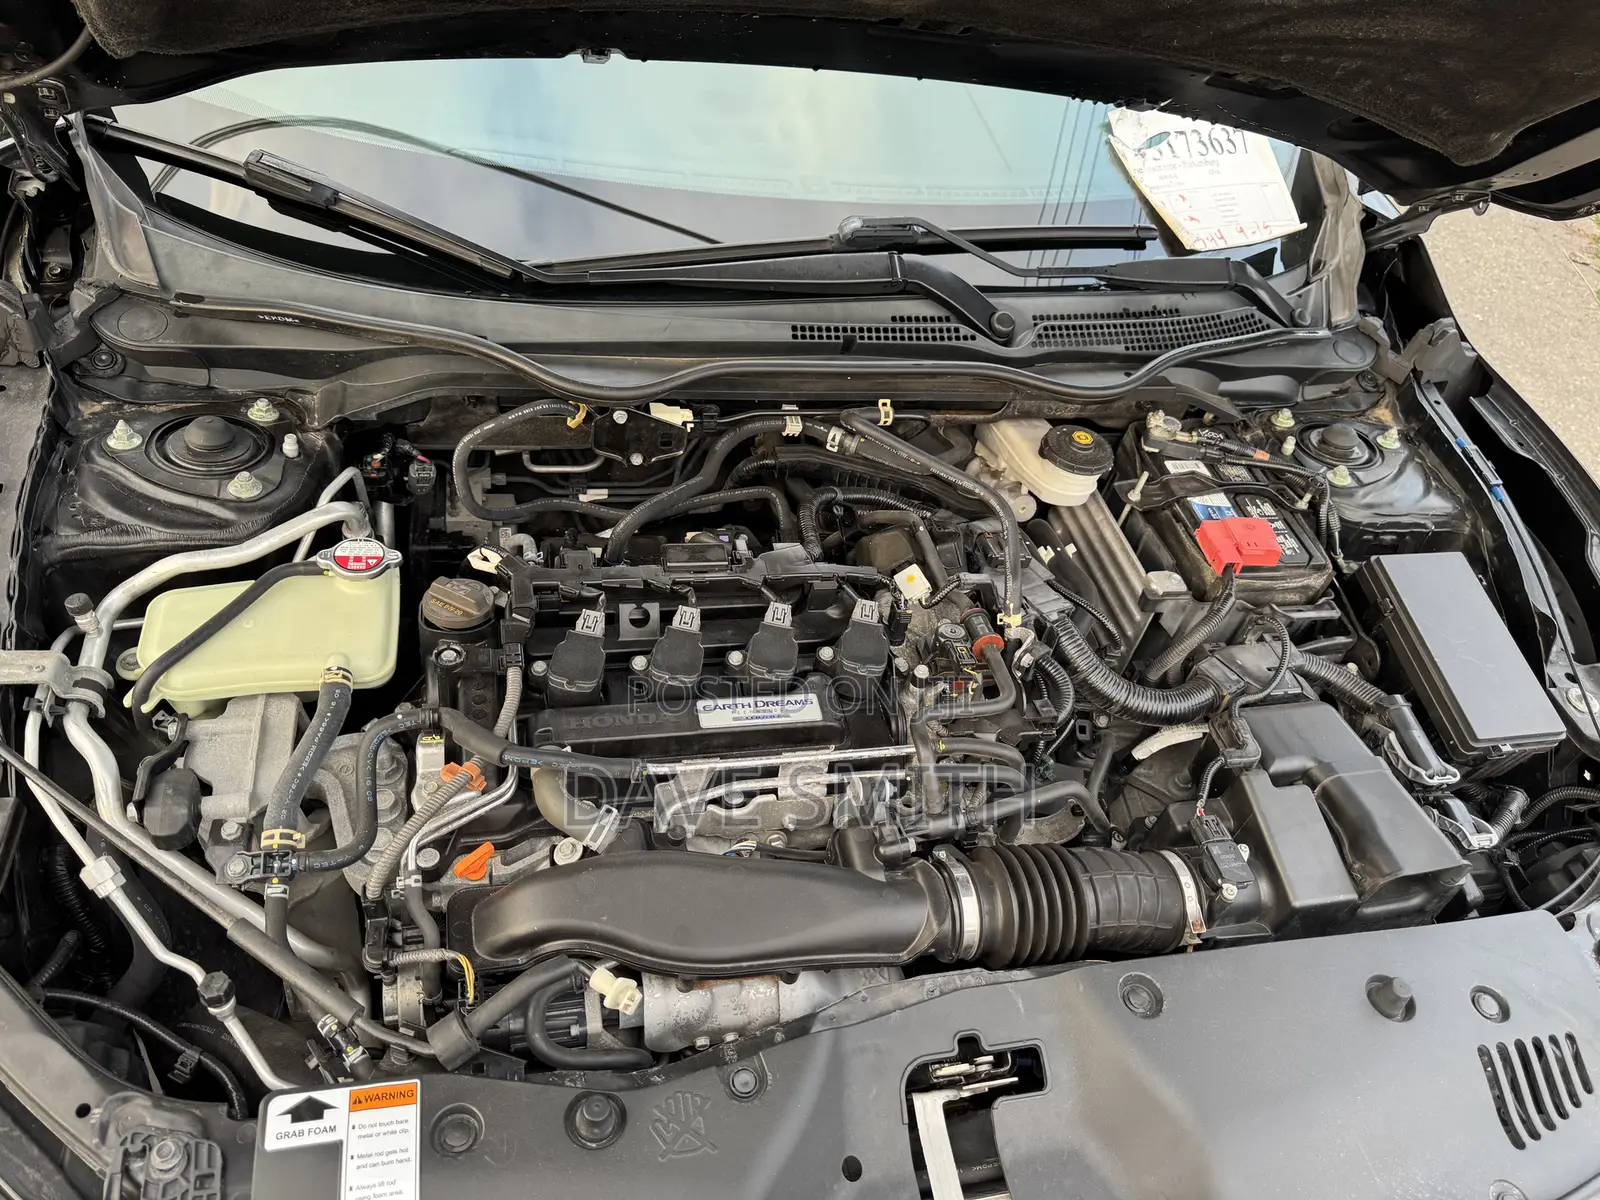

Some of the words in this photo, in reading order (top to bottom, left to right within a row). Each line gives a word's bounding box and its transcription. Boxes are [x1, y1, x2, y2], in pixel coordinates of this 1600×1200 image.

[430, 598, 445, 608] SAE
[702, 702, 752, 712] EARTH
[754, 697, 814, 710] DREAMS
[568, 711, 679, 730] HONDA
[364, 1089, 415, 1103] WARNING
[378, 1120, 395, 1128] touch
[275, 1128, 305, 1141] GRAB
[307, 1125, 337, 1136] FOAM
[386, 1178, 397, 1186] rod
